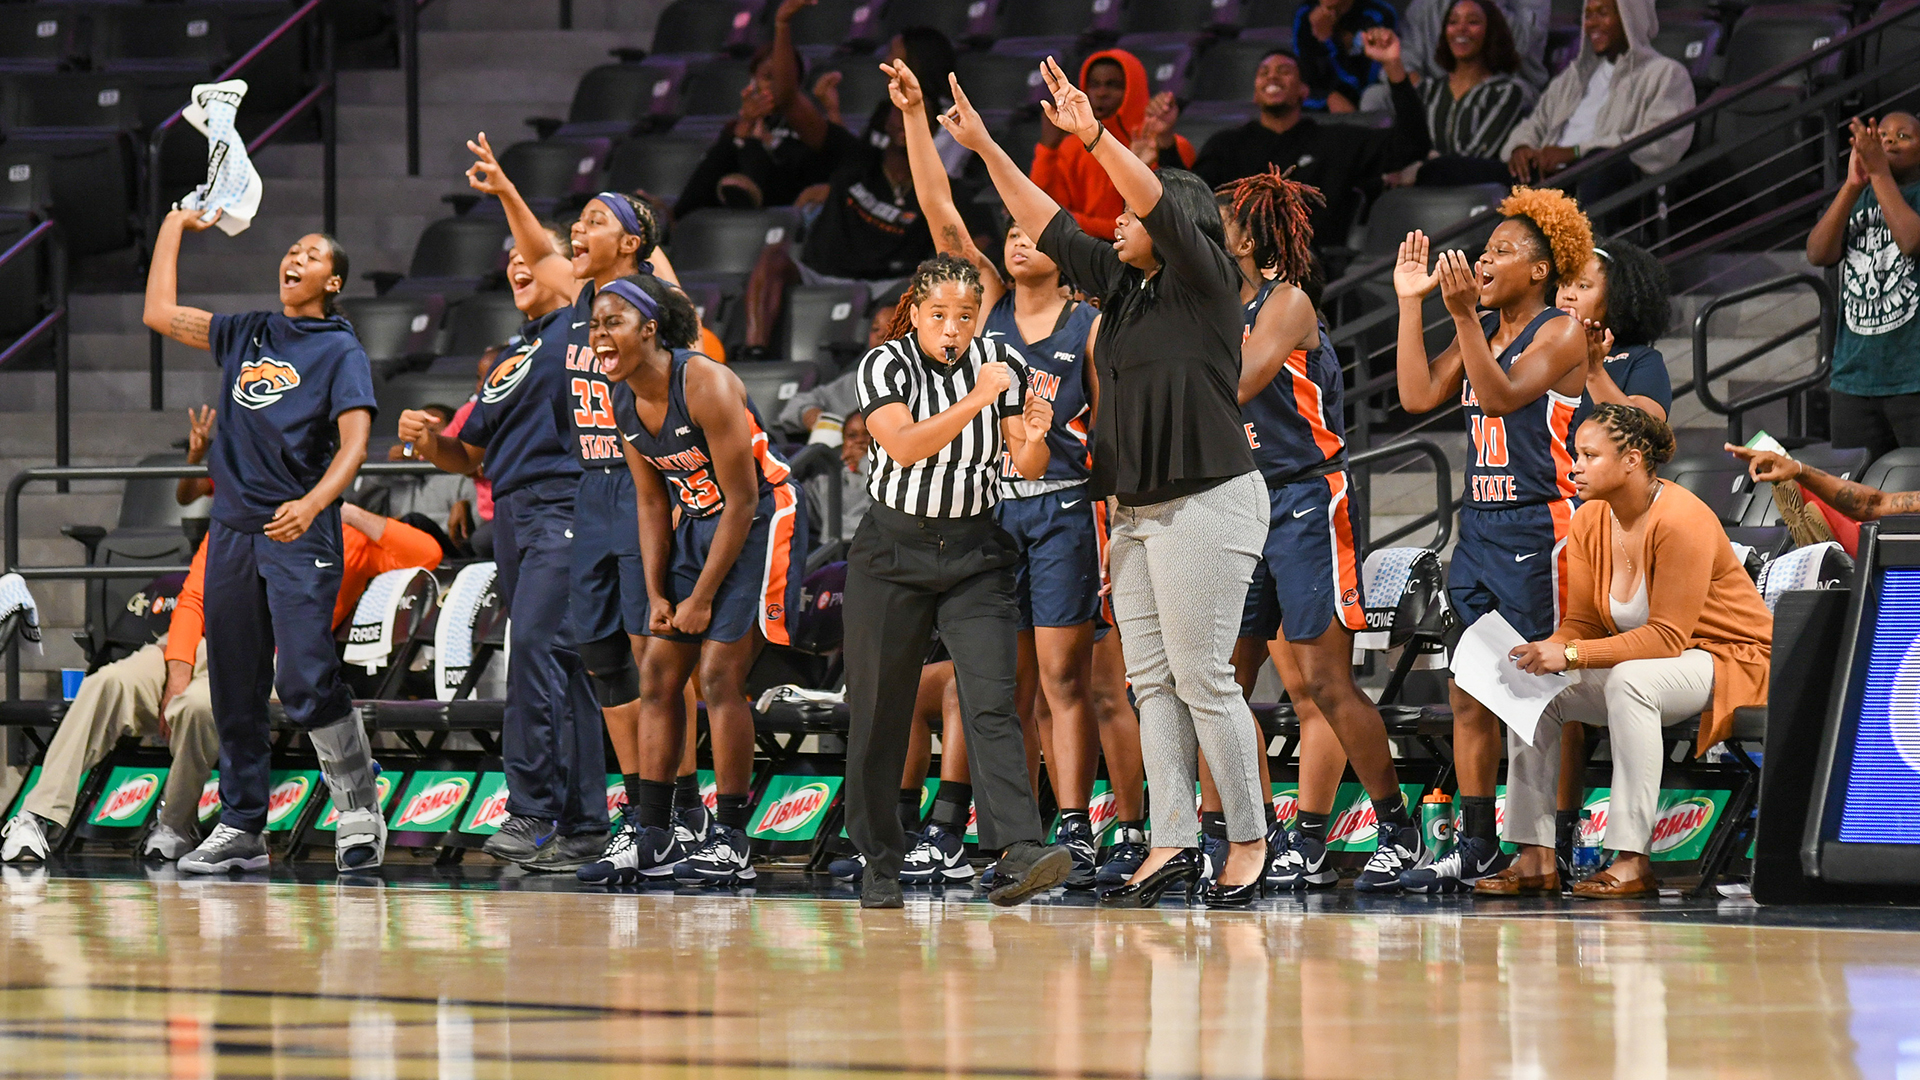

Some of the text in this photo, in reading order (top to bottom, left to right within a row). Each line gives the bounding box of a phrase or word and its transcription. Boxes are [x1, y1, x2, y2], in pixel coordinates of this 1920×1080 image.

[1053, 351, 1076, 363] PBC
[571, 377, 617, 429] 33
[579, 435, 624, 460] STATE
[1471, 414, 1509, 468] 10
[1472, 475, 1518, 502] STATE
[95, 783, 154, 823] LIBMAN
[396, 784, 463, 828] LIBMAN
[754, 790, 827, 835] LIBMAN
[1326, 805, 1379, 845] LIBM
[1651, 804, 1711, 844] BMAN
